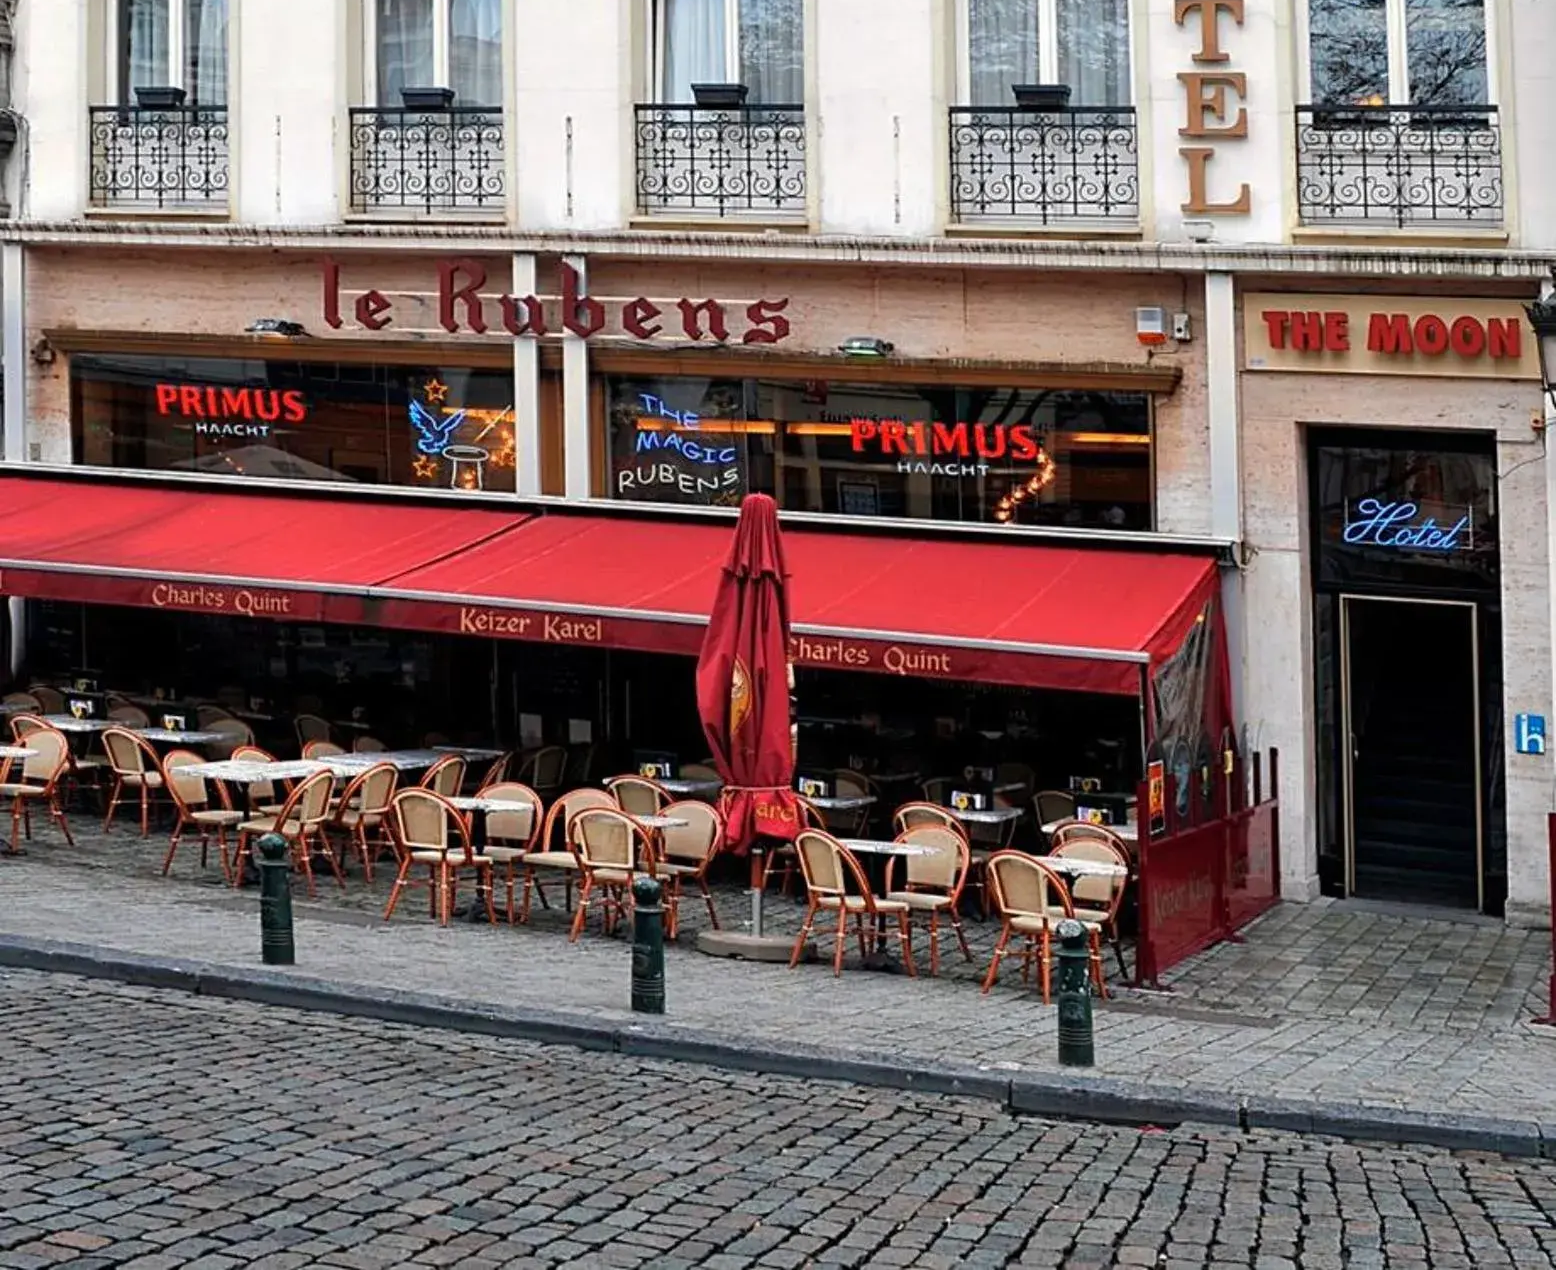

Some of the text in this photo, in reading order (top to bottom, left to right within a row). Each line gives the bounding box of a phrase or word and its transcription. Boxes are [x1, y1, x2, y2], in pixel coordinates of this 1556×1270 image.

[320, 256, 790, 345] le Rubens
[1262, 311, 1522, 359] THE MOON
[155, 383, 307, 422] PRIMUS
[639, 393, 700, 430] THE
[195, 422, 270, 437] HAACHT
[850, 418, 1038, 461] PRIMUS
[636, 431, 736, 464] MAGIC
[618, 463, 739, 494] RUBENS
[897, 461, 989, 477] HAACHT
[1343, 498, 1468, 549] Hotel
[152, 584, 291, 616] Charles Quint
[460, 607, 601, 641] Keizer Karel
[883, 646, 951, 676] Quint
